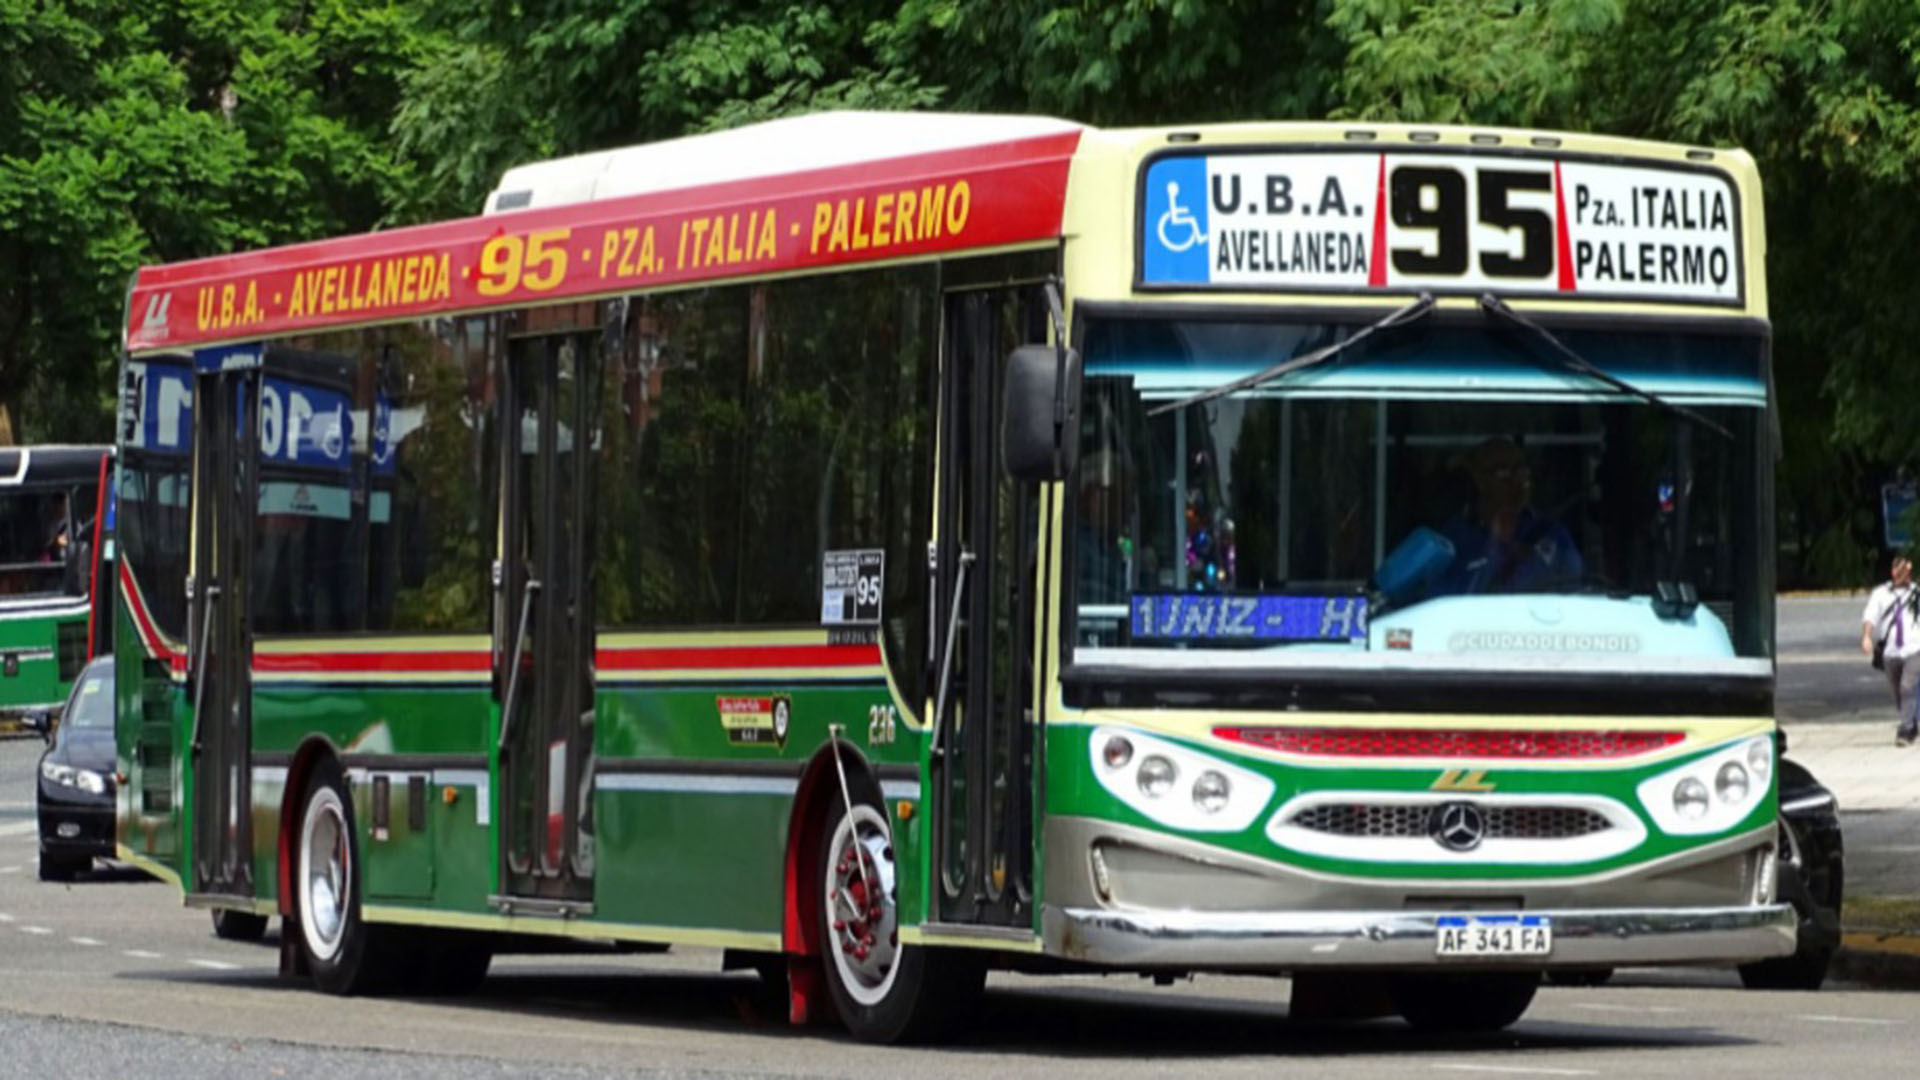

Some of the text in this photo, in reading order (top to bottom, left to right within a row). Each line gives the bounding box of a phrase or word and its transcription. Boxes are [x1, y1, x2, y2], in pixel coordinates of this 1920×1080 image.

[1210, 174, 1363, 216] U.B.A.
[1632, 187, 1729, 231] ITALIA
[1389, 165, 1555, 279] 95
[197, 180, 971, 330] U.B.A. AVELLANEDA 95 PZA. ITALIA PALERMO
[1216, 230, 1368, 273] AVELLANEDA
[1577, 241, 1728, 285] PALERMO
[857, 576, 880, 605] 95
[1443, 929, 1546, 950] AF 341 FA
